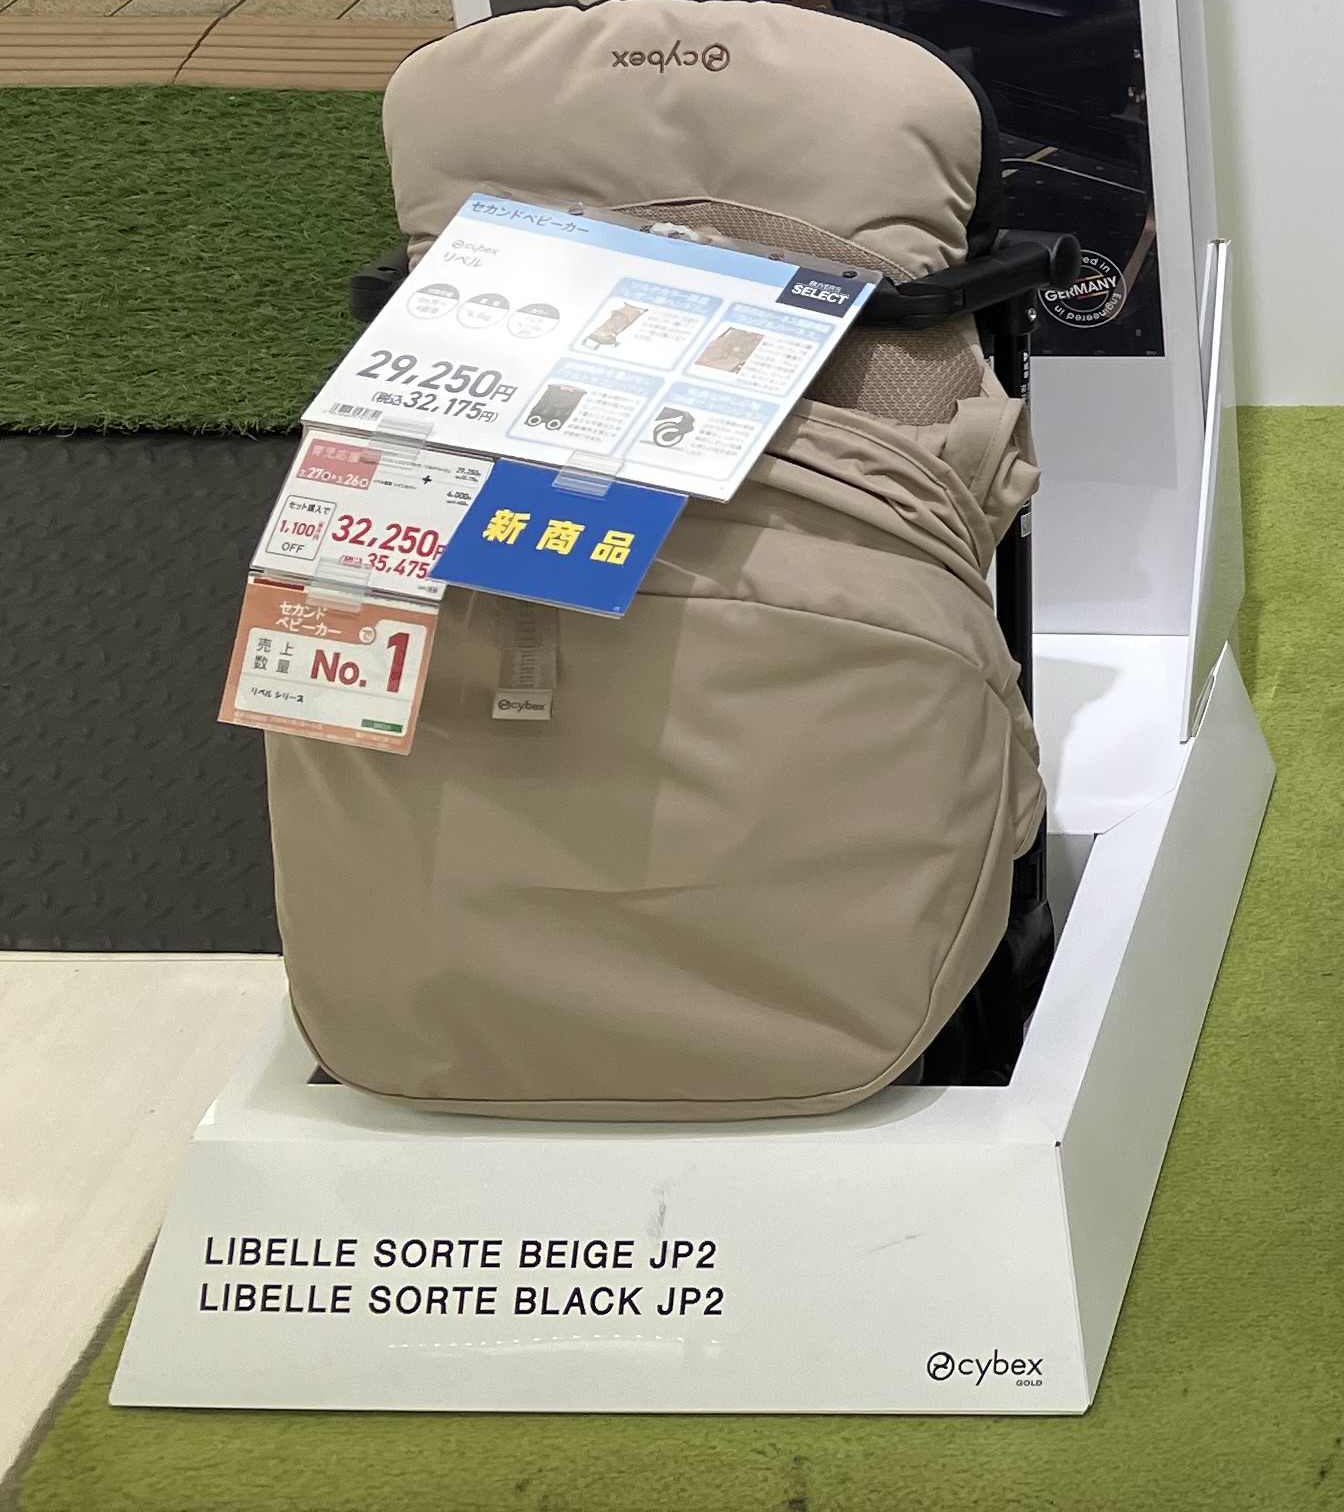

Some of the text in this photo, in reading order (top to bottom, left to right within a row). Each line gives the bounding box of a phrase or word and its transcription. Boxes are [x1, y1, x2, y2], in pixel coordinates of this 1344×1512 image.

[611, 39, 699, 73] cybex
[471, 201, 590, 234] セカンドベビーカー
[443, 252, 483, 268] リベル
[791, 284, 850, 305] SELECT
[1044, 275, 1118, 302] GERMANY
[356, 349, 518, 403] 29,250円
[279, 519, 316, 538] 1,100
[481, 508, 636, 565] 新商品
[281, 541, 305, 554] OFF
[279, 600, 328, 620] セカンド
[275, 617, 343, 637] ベビーカー
[310, 631, 411, 694] No. 1
[510, 699, 546, 712] cybex
[204, 1236, 718, 1271] LIBELLE SORTE BEIGE JP2
[199, 1283, 725, 1317] LIBELLE SORTE BLACK JP2
[958, 1349, 1044, 1386] cybex
[1015, 1379, 1043, 1387] GOLD
